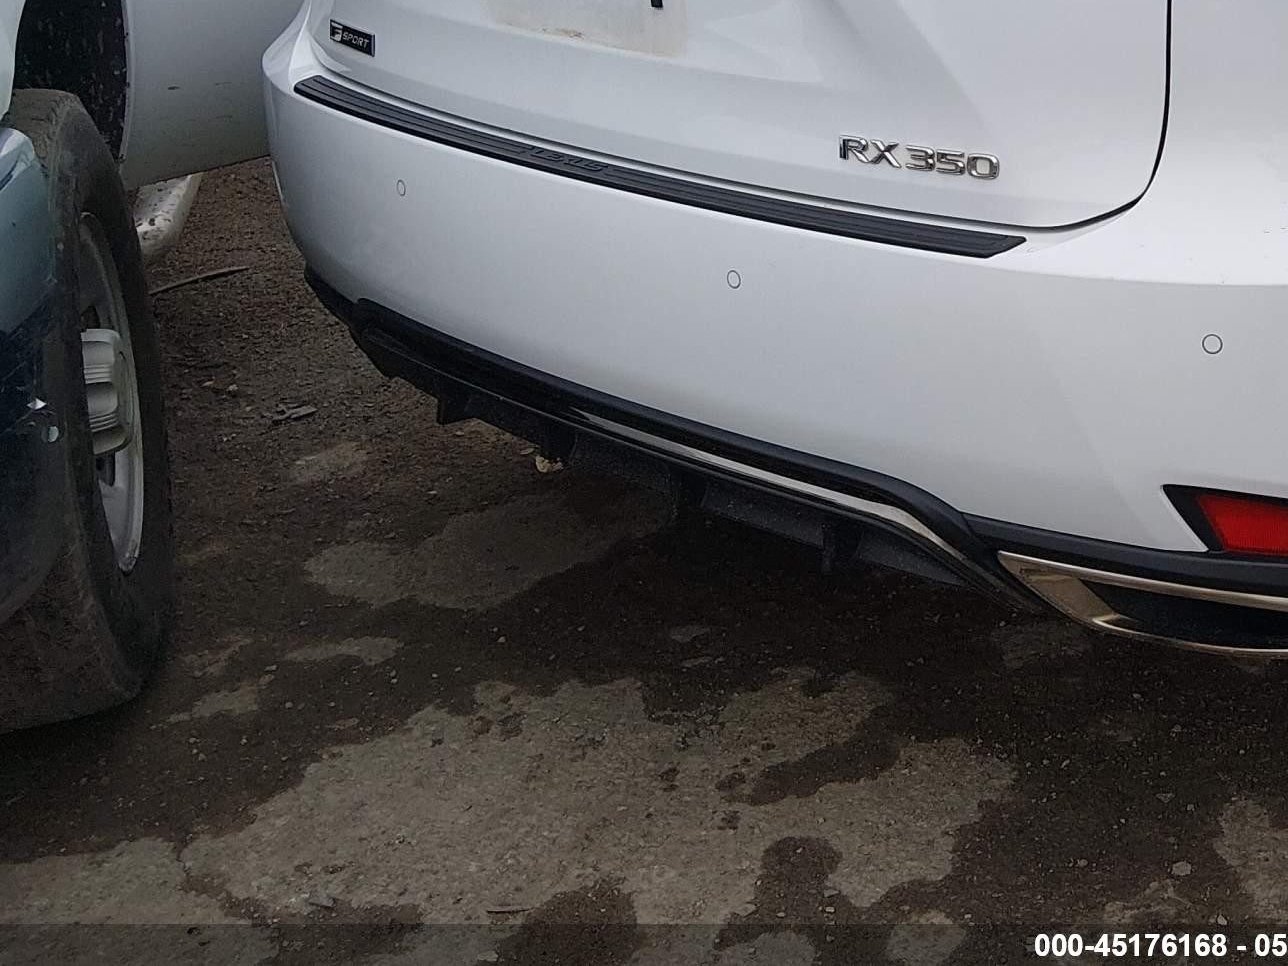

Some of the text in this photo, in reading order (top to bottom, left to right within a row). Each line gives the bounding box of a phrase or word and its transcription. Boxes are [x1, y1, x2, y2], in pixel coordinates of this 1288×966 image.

[343, 31, 370, 49] SPORT
[839, 135, 1000, 180] RX 350
